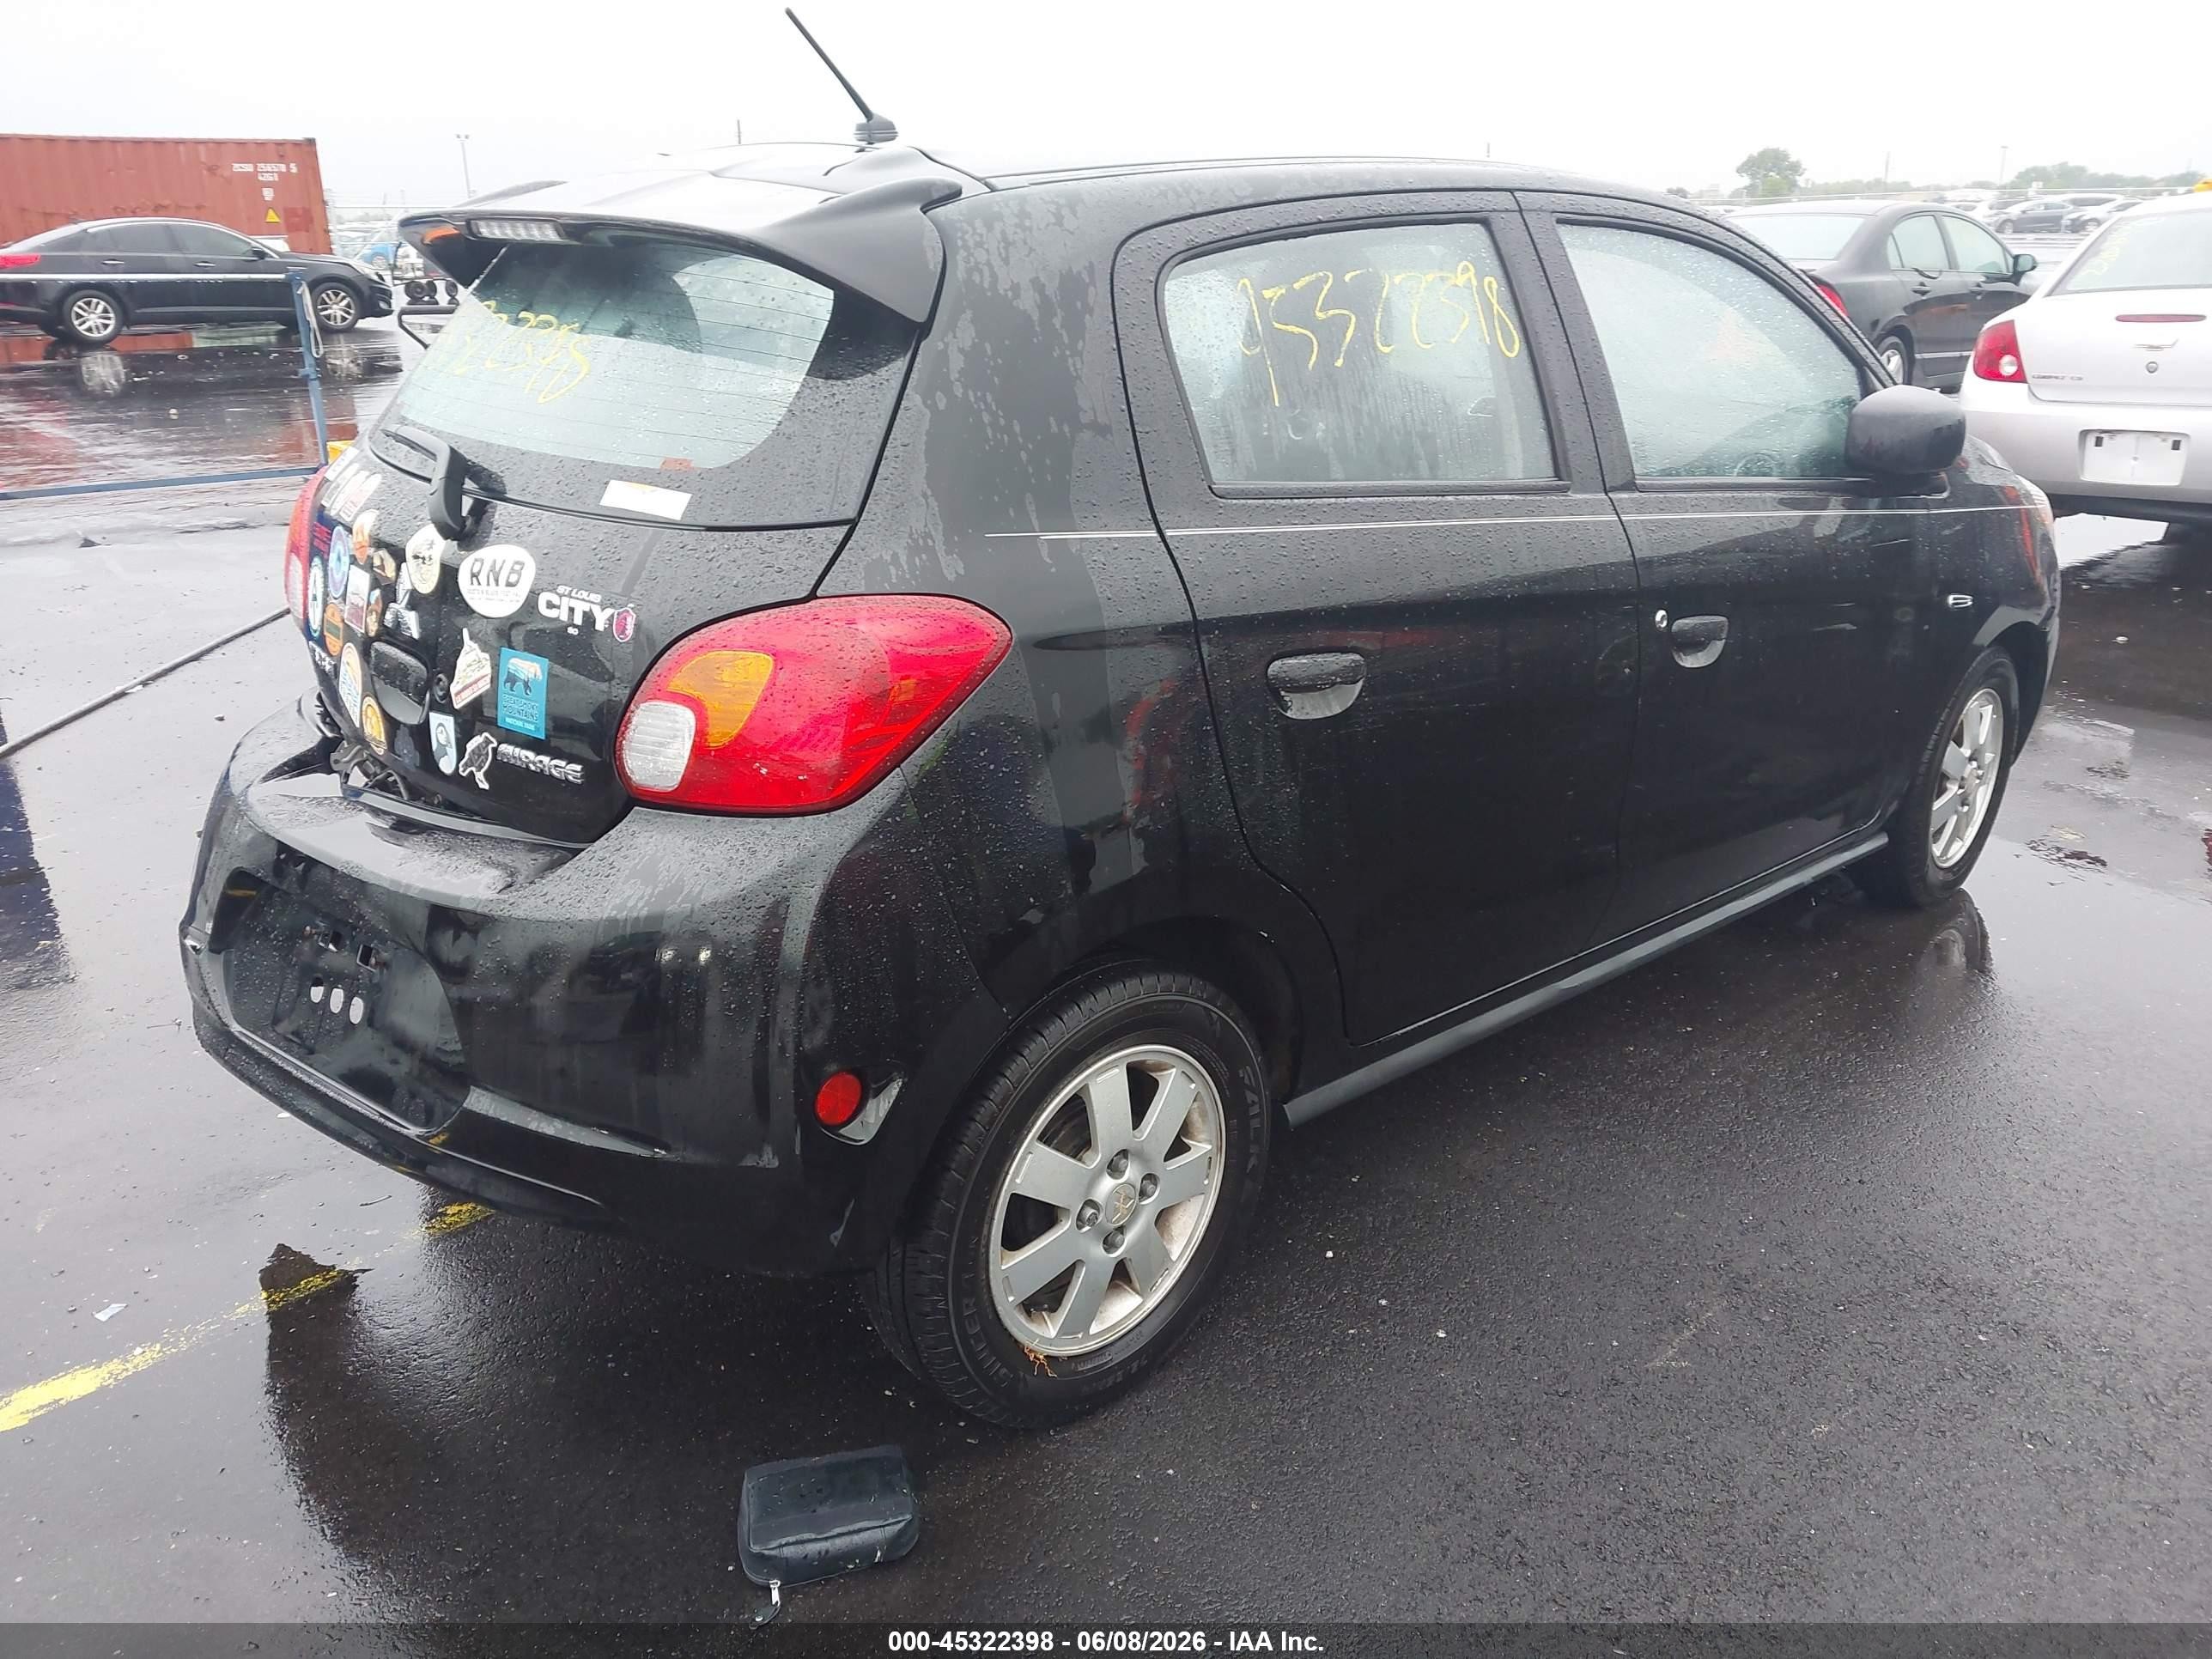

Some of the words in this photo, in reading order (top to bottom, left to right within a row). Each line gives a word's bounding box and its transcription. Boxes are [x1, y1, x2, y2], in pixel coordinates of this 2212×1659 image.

[469, 557, 526, 587] RNB
[538, 591, 615, 631] CITY
[555, 585, 568, 594] ST
[570, 588, 601, 602] LOUIS
[495, 744, 585, 784] MIRAGE
